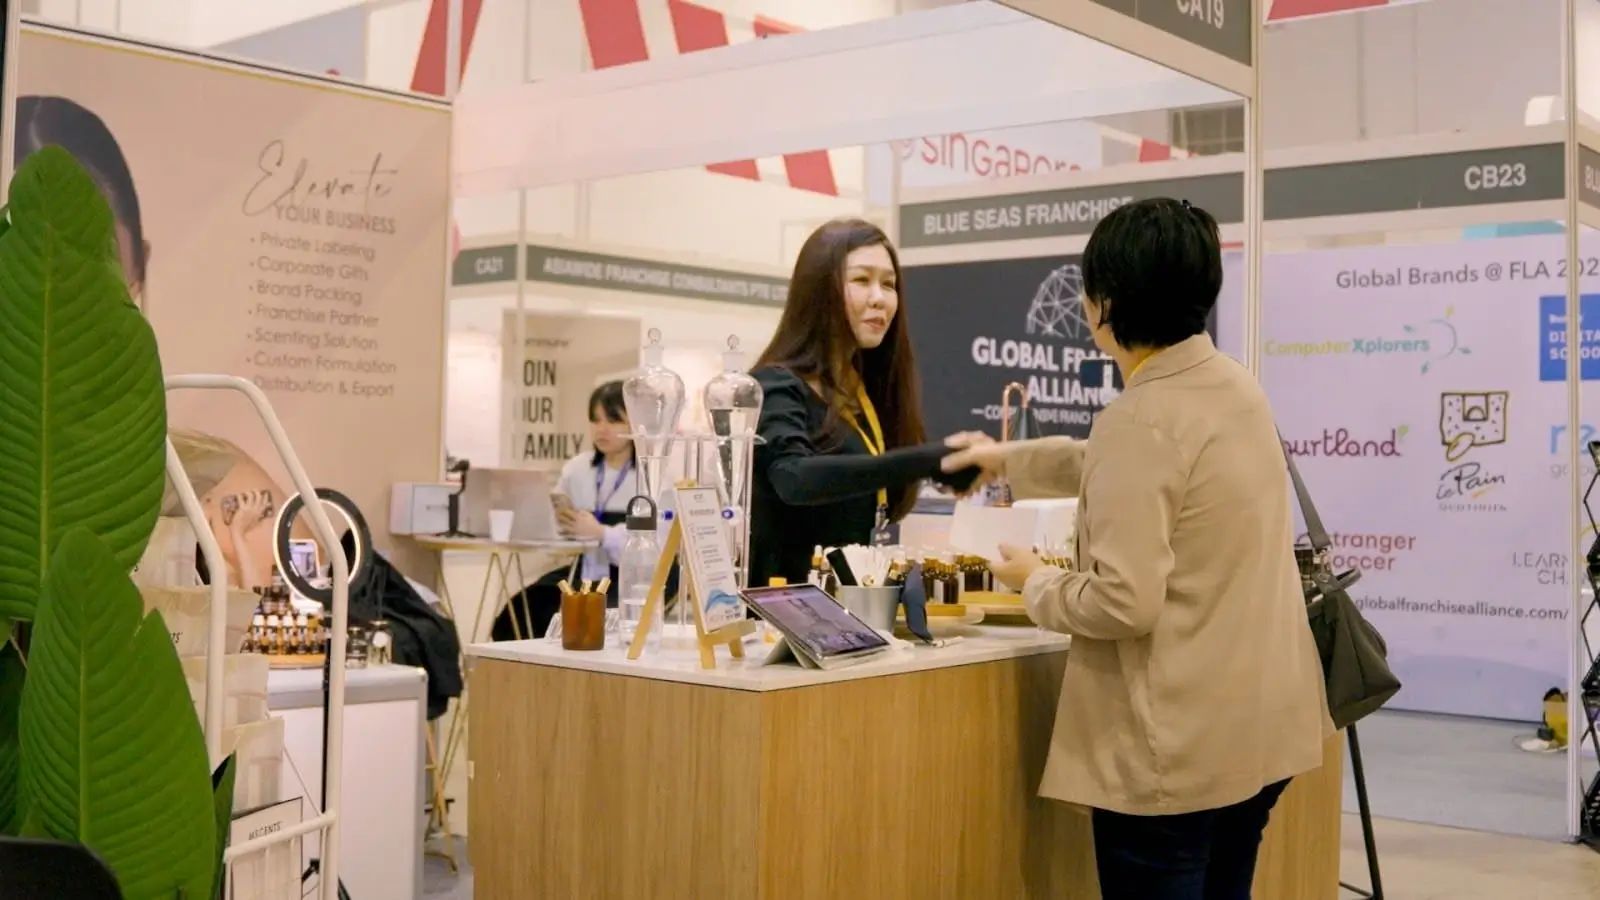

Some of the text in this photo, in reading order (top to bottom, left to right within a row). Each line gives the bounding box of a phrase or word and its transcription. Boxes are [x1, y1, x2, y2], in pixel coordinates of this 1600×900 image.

[241, 139, 398, 217] Elevate
[1463, 162, 1527, 191] CB23
[274, 203, 396, 235] YOUR BUSINESS
[923, 212, 971, 236] BLUE
[974, 205, 1022, 231] SEAS
[260, 231, 311, 252] Private
[257, 256, 334, 278] Corporate
[1335, 268, 1403, 290] Global
[1408, 264, 1480, 286] Brands
[1484, 261, 1503, 282] @
[1509, 260, 1551, 281] FLA
[256, 279, 363, 307] Brand Packing
[256, 303, 379, 327] Franchise Partner
[254, 327, 378, 351] Scenting Solution
[1263, 336, 1431, 358] ComputerXplorers
[253, 350, 397, 374] Custom Formulation
[971, 336, 1060, 373] GLOBAL
[253, 374, 395, 398] Distribution & Export
[523, 359, 557, 387] OIN
[522, 432, 584, 461] AMILY
[1440, 462, 1505, 496] Pain
[1333, 531, 1417, 554] tranger
[1331, 554, 1396, 572] occer
